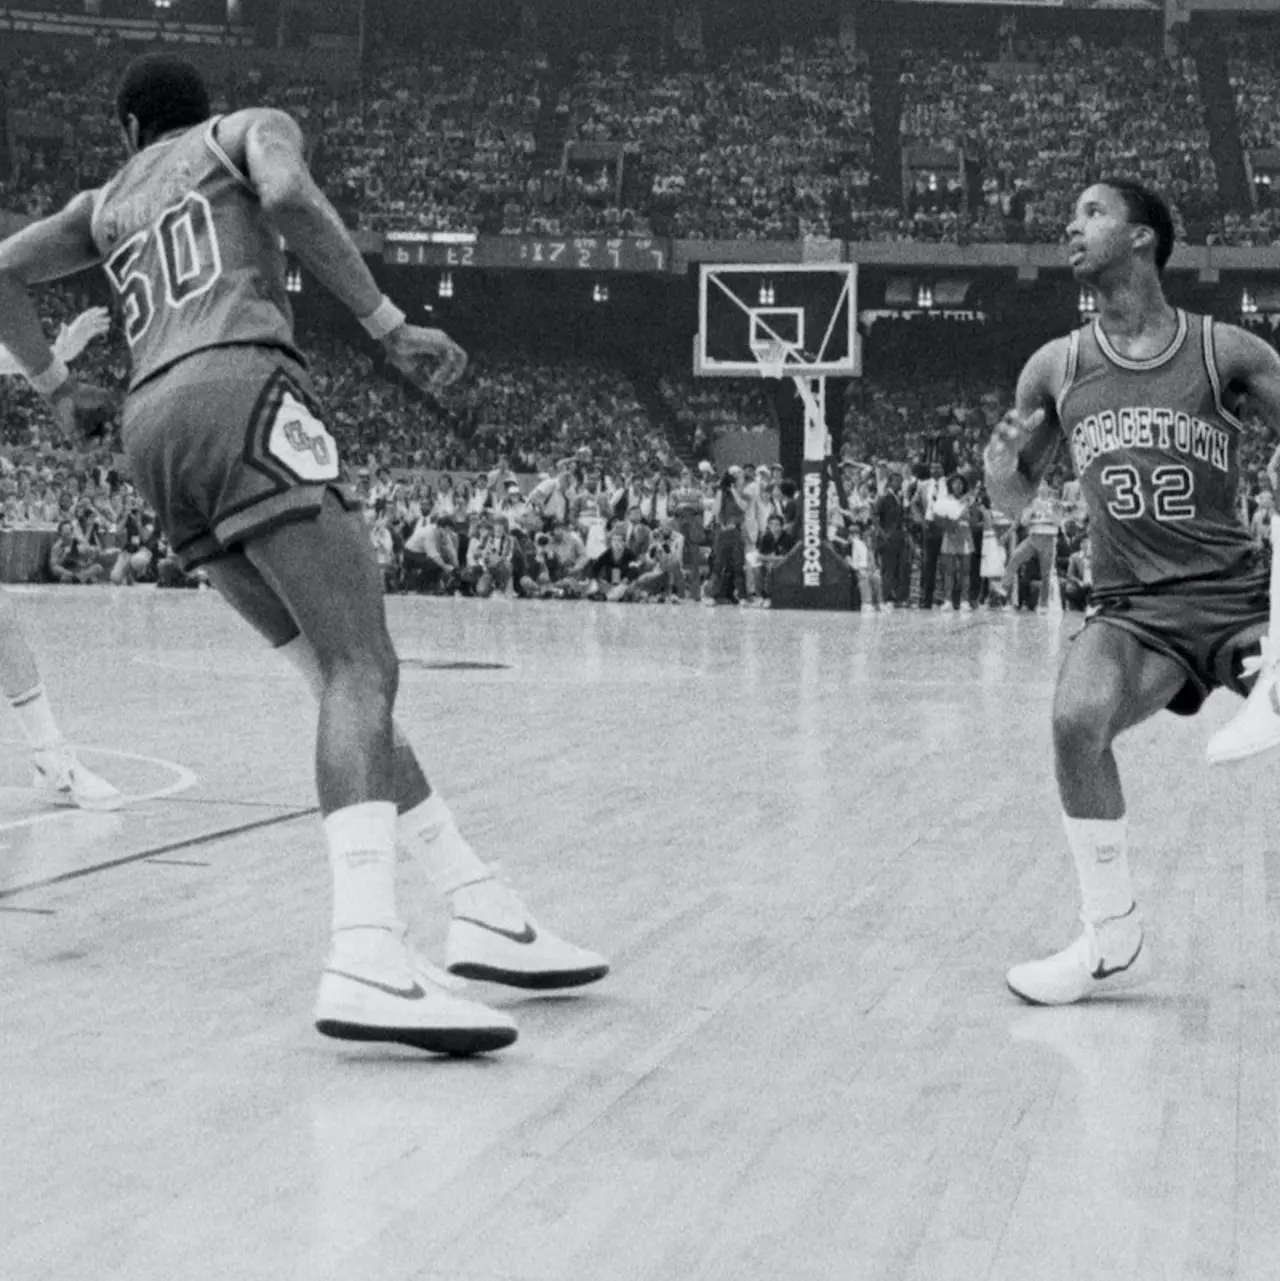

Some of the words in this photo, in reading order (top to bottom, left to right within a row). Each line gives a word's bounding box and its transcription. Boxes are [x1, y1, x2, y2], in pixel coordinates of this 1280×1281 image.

[103, 190, 222, 347] 50
[802, 472, 823, 587] SUPERDOME
[1101, 465, 1196, 520] 32
